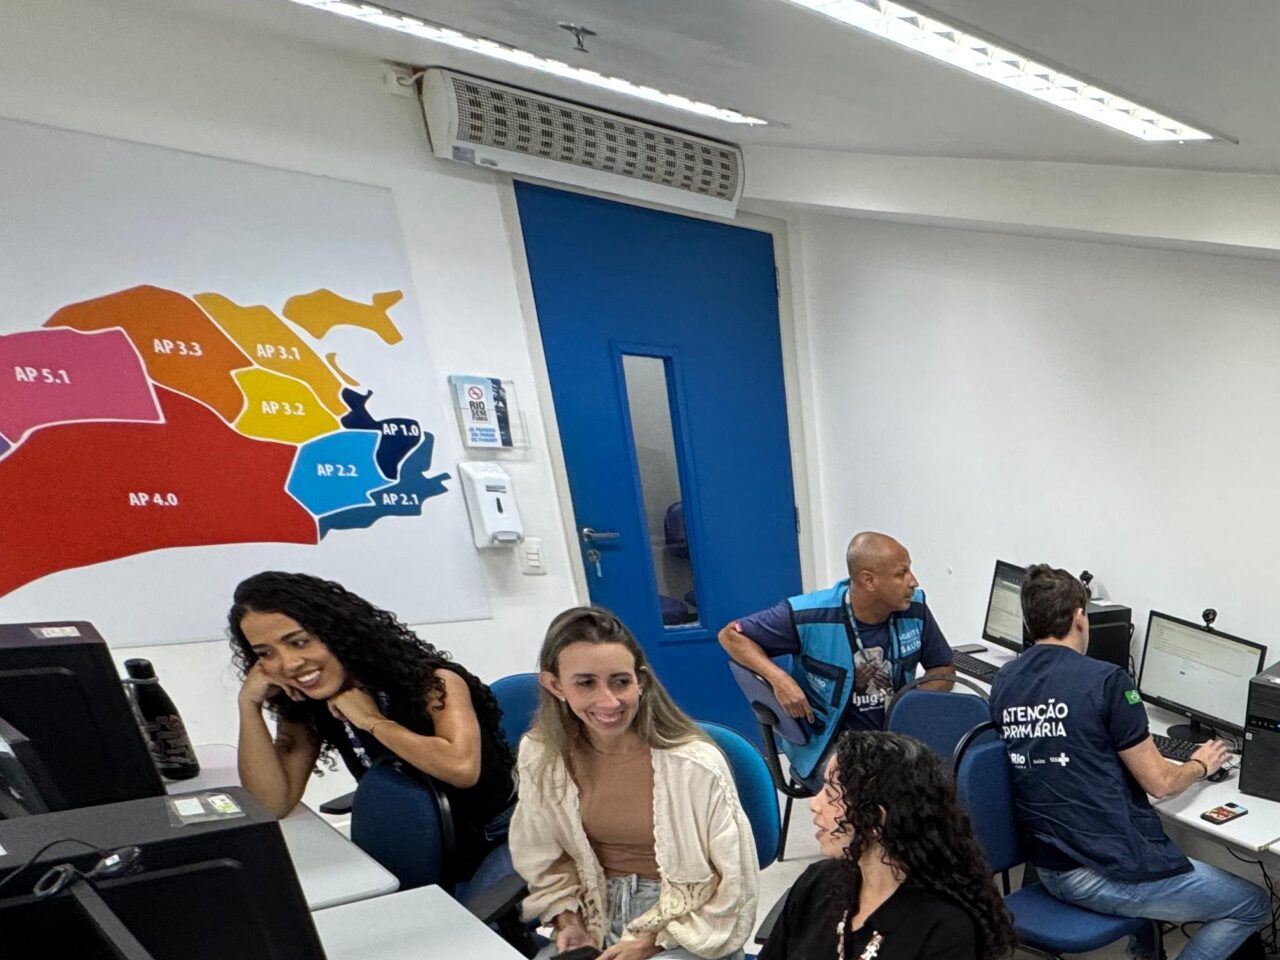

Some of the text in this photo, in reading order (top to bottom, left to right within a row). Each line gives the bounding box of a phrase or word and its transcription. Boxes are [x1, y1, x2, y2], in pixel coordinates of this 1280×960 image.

[154, 339, 203, 357] AP 3.3
[256, 344, 301, 360] AP 3.1
[14, 366, 72, 384] AP 5.1
[262, 401, 306, 416] AP 3.2
[469, 401, 485, 410] RIO
[382, 423, 419, 437] AP 1.0
[317, 464, 358, 477] AP 2.2
[129, 492, 178, 506] AP 4.0
[382, 493, 419, 505] AP 2.1
[1003, 698, 1068, 725] ATENÇÃO
[1002, 721, 1067, 739] PRIMÁRIA
